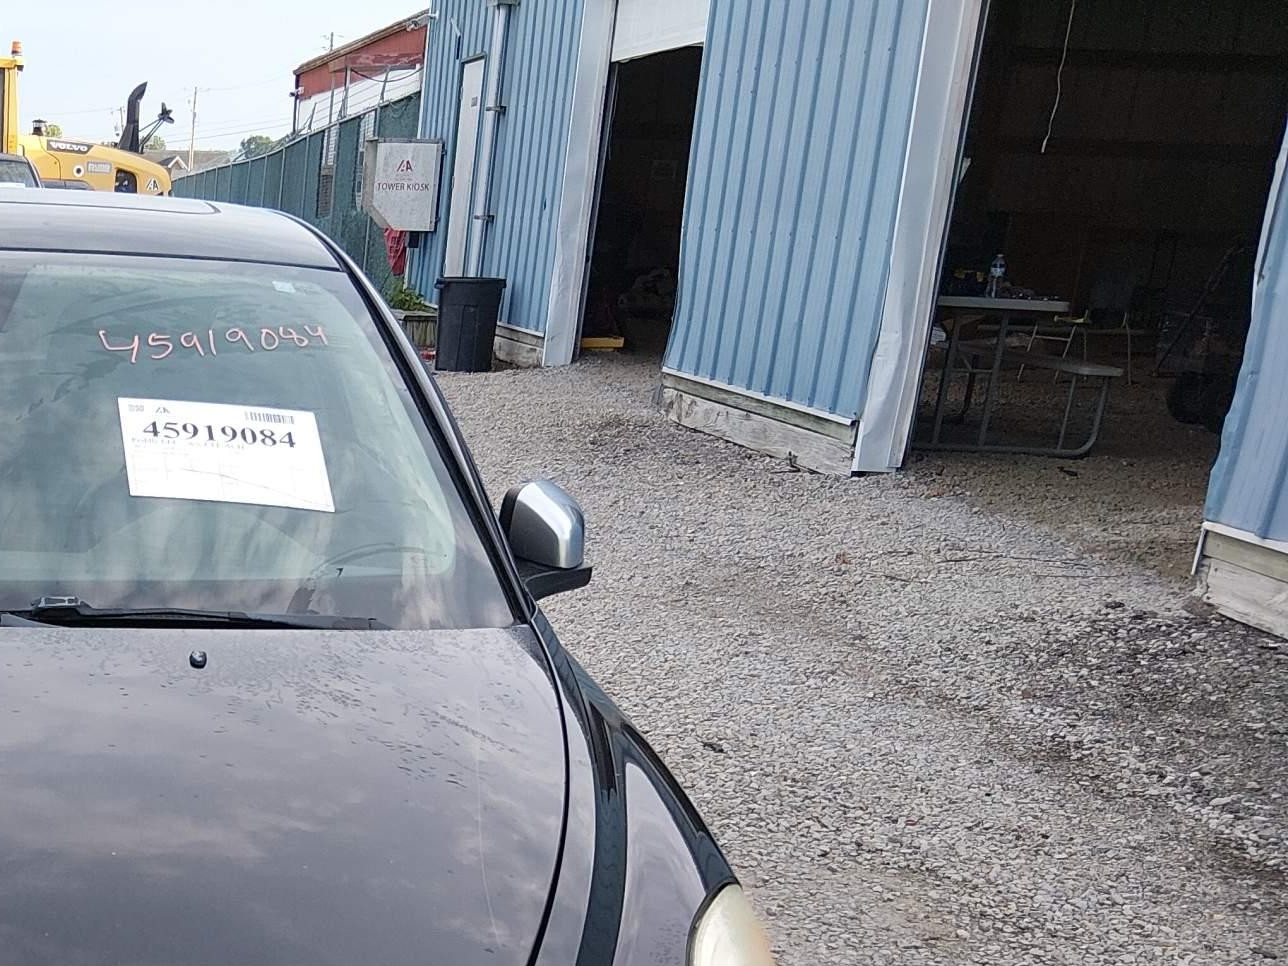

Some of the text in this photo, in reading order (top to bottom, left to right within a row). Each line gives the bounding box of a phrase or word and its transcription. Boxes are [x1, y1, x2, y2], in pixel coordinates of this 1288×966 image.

[50, 141, 88, 152] VOLVO
[377, 182, 430, 192] TOWER KIOSK
[98, 325, 328, 364] 45919084
[143, 420, 296, 449] 45919084
